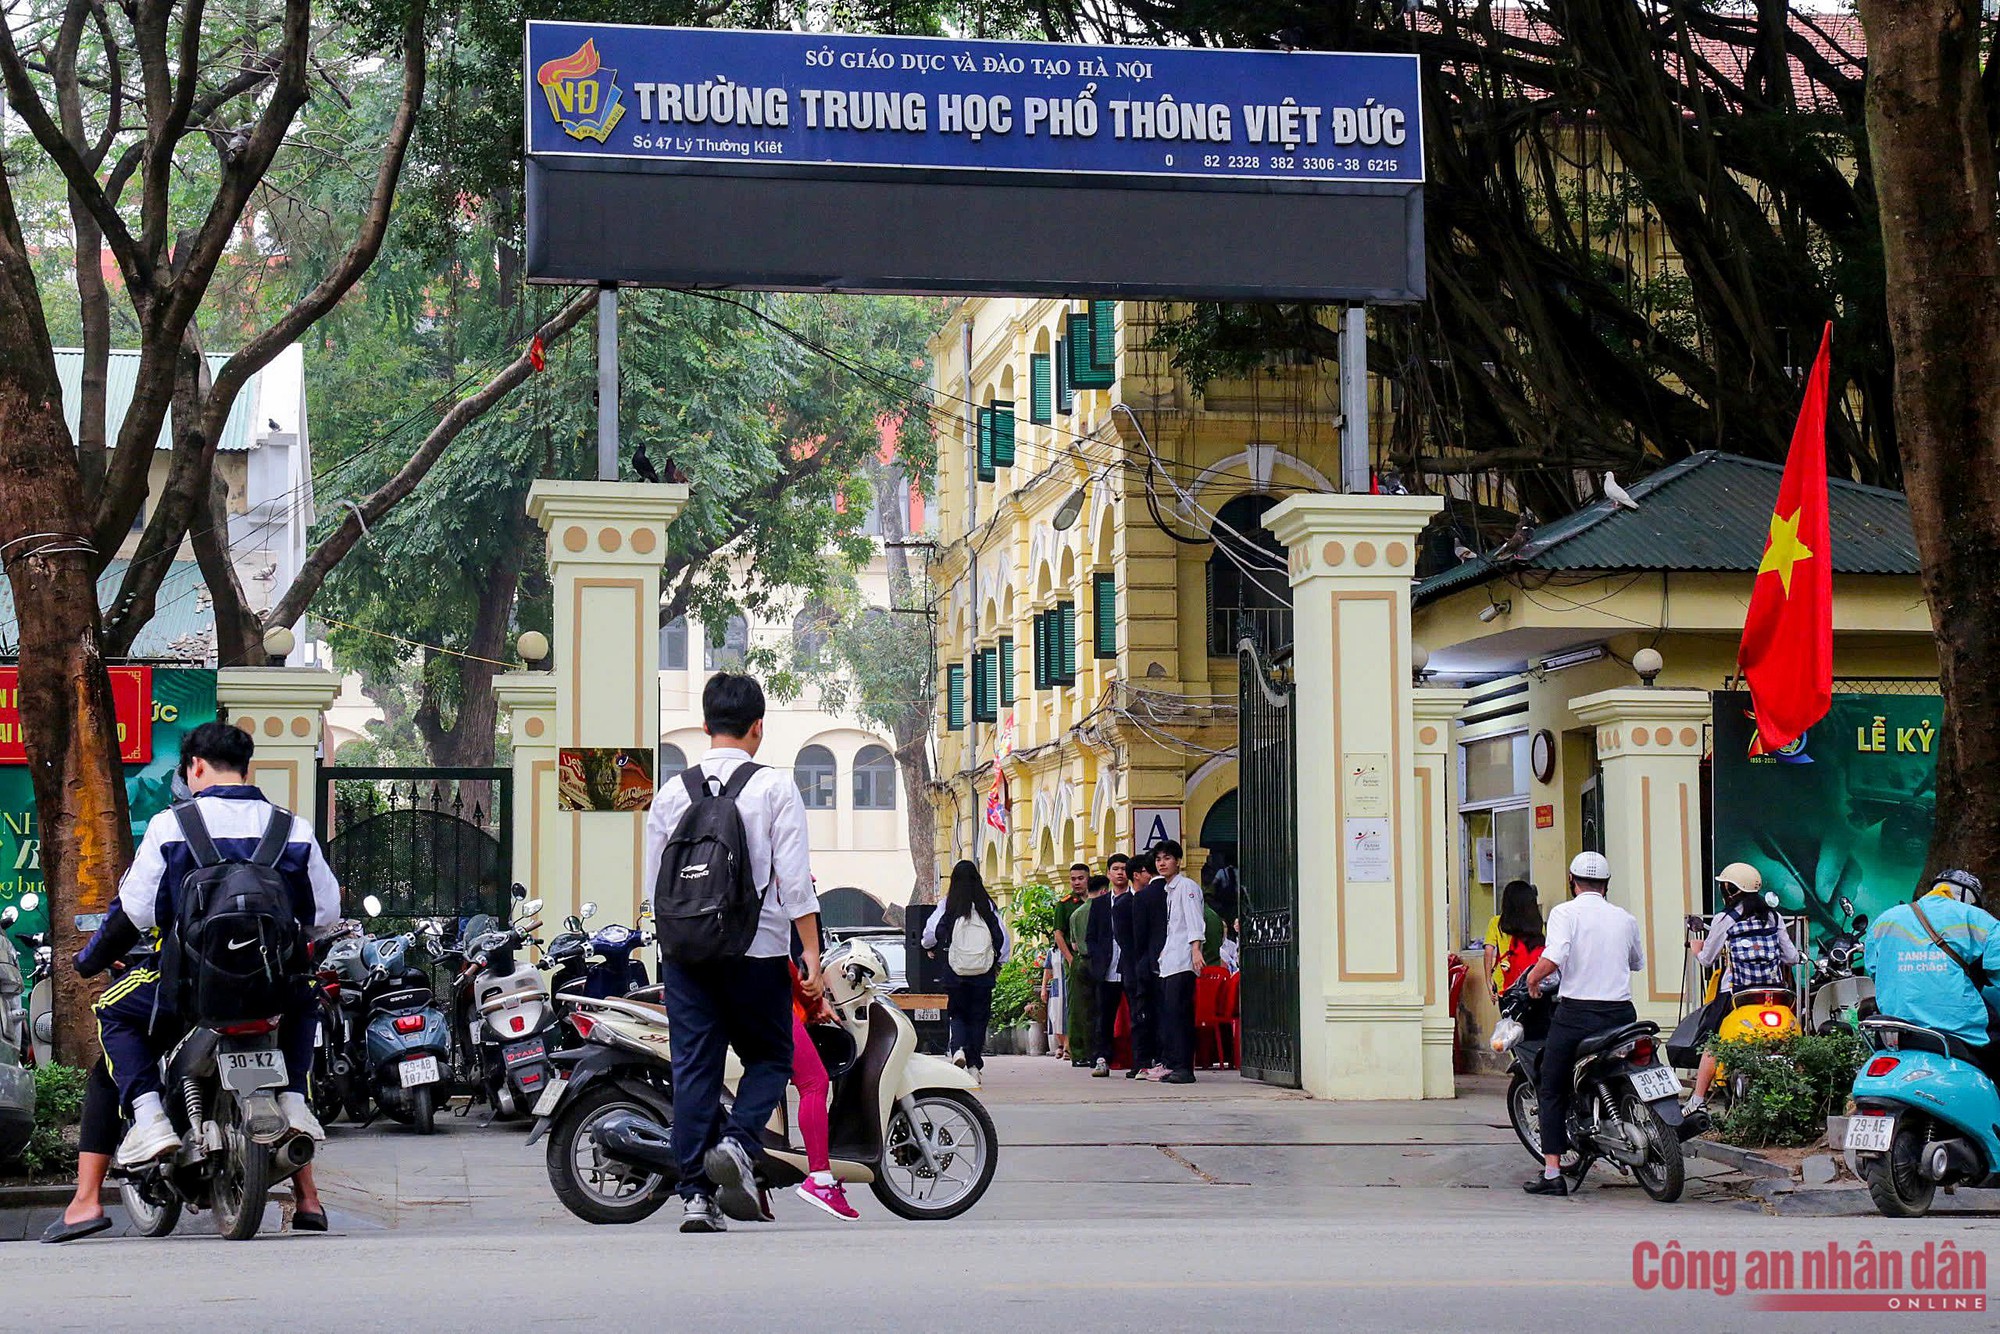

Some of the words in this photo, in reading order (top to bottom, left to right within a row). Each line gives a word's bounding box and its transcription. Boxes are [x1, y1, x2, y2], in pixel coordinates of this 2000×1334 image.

[805, 45, 835, 67] SỞ
[840, 48, 895, 69] GIÁO
[901, 53, 946, 75] DỤC
[951, 51, 977, 72] VÀ
[983, 53, 1025, 74] ĐÀO
[1031, 59, 1071, 80] TẠO
[1078, 56, 1109, 77] HÀ
[1116, 60, 1153, 82] NỘI
[634, 74, 789, 127] TRƯỜNG
[800, 89, 927, 132] TRUNG
[938, 93, 1013, 140] HỌC
[1024, 82, 1098, 137] PHỔ
[1109, 93, 1231, 142] THÔNG
[1243, 97, 1321, 150] VIỆT
[1332, 98, 1406, 146] ĐỨC
[655, 137, 673, 150] 47
[676, 137, 693, 153] Lý
[1204, 155, 1220, 168] 82
[1228, 156, 1260, 169] 2328
[1270, 157, 1295, 169] 382
[1368, 158, 1398, 172] 6215
[1857, 715, 1886, 751] LỄ
[1897, 719, 1936, 752] KỶ
[1142, 814, 1169, 851] A
[1853, 1119, 1886, 1133] 29-AE
[1849, 1133, 1886, 1148] 160.14
